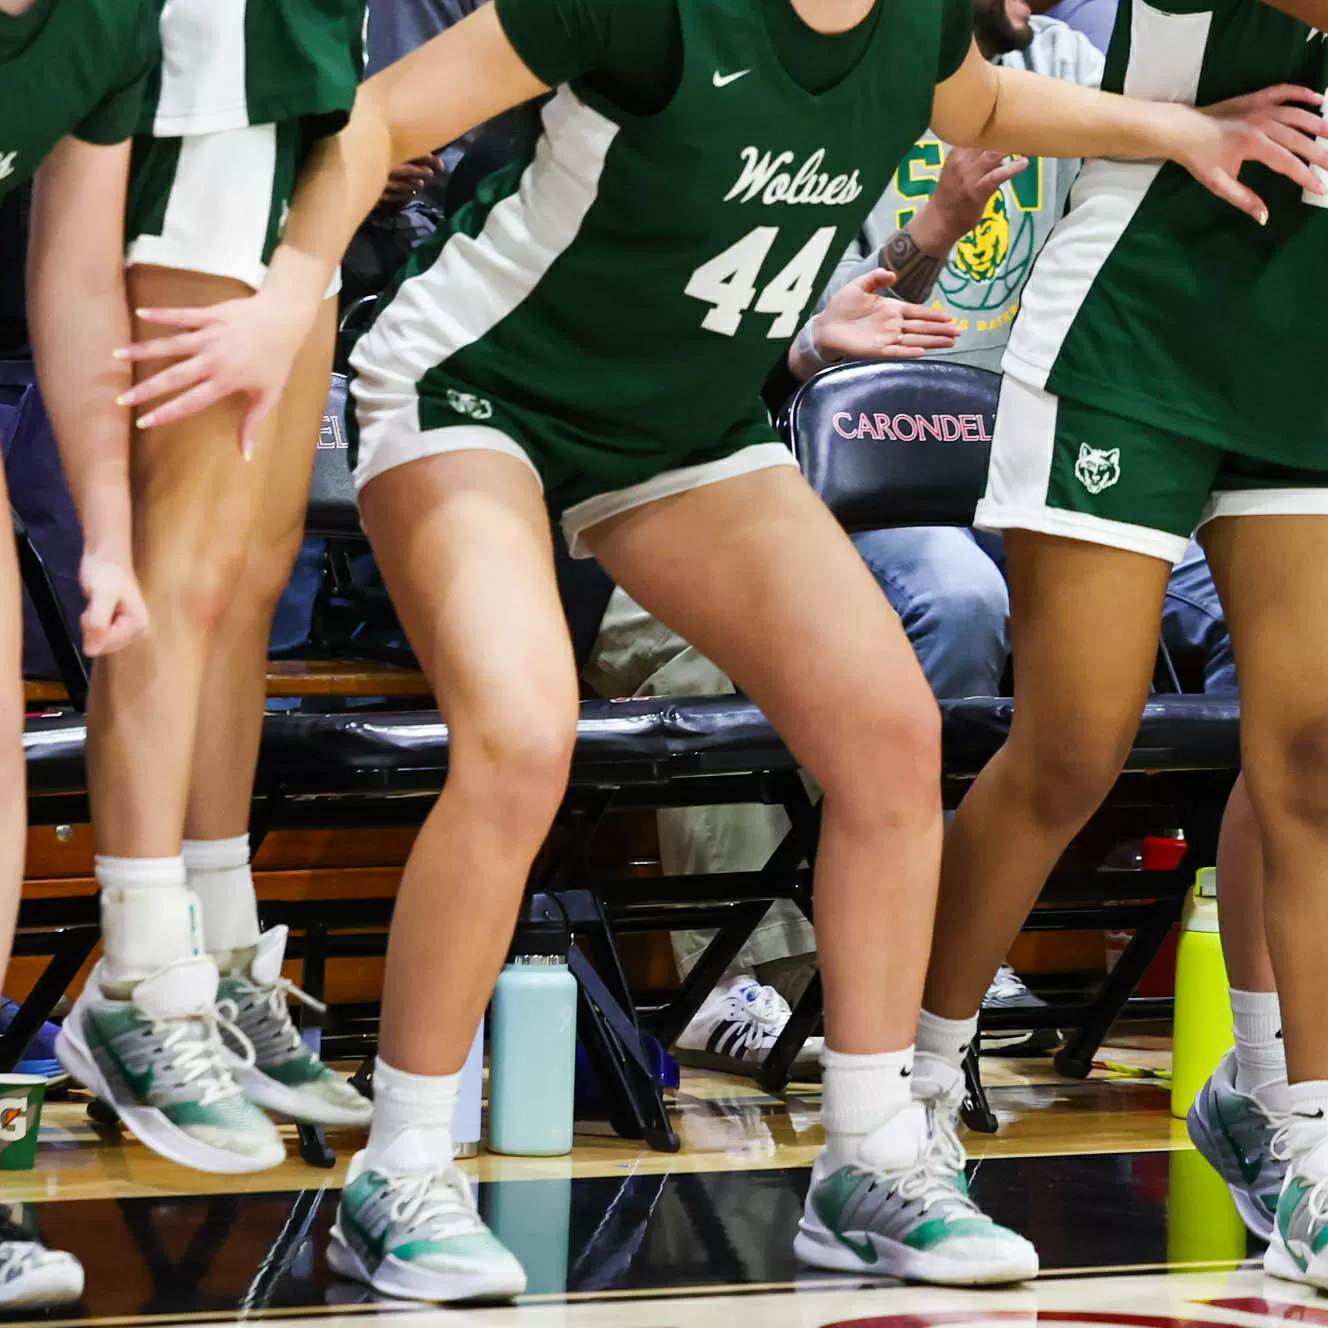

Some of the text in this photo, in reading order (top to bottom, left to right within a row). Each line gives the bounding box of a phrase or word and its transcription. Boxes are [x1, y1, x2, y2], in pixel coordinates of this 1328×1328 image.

[723, 146, 863, 205] Wolves
[684, 225, 837, 339] 44
[832, 411, 996, 441] CARONDEL
